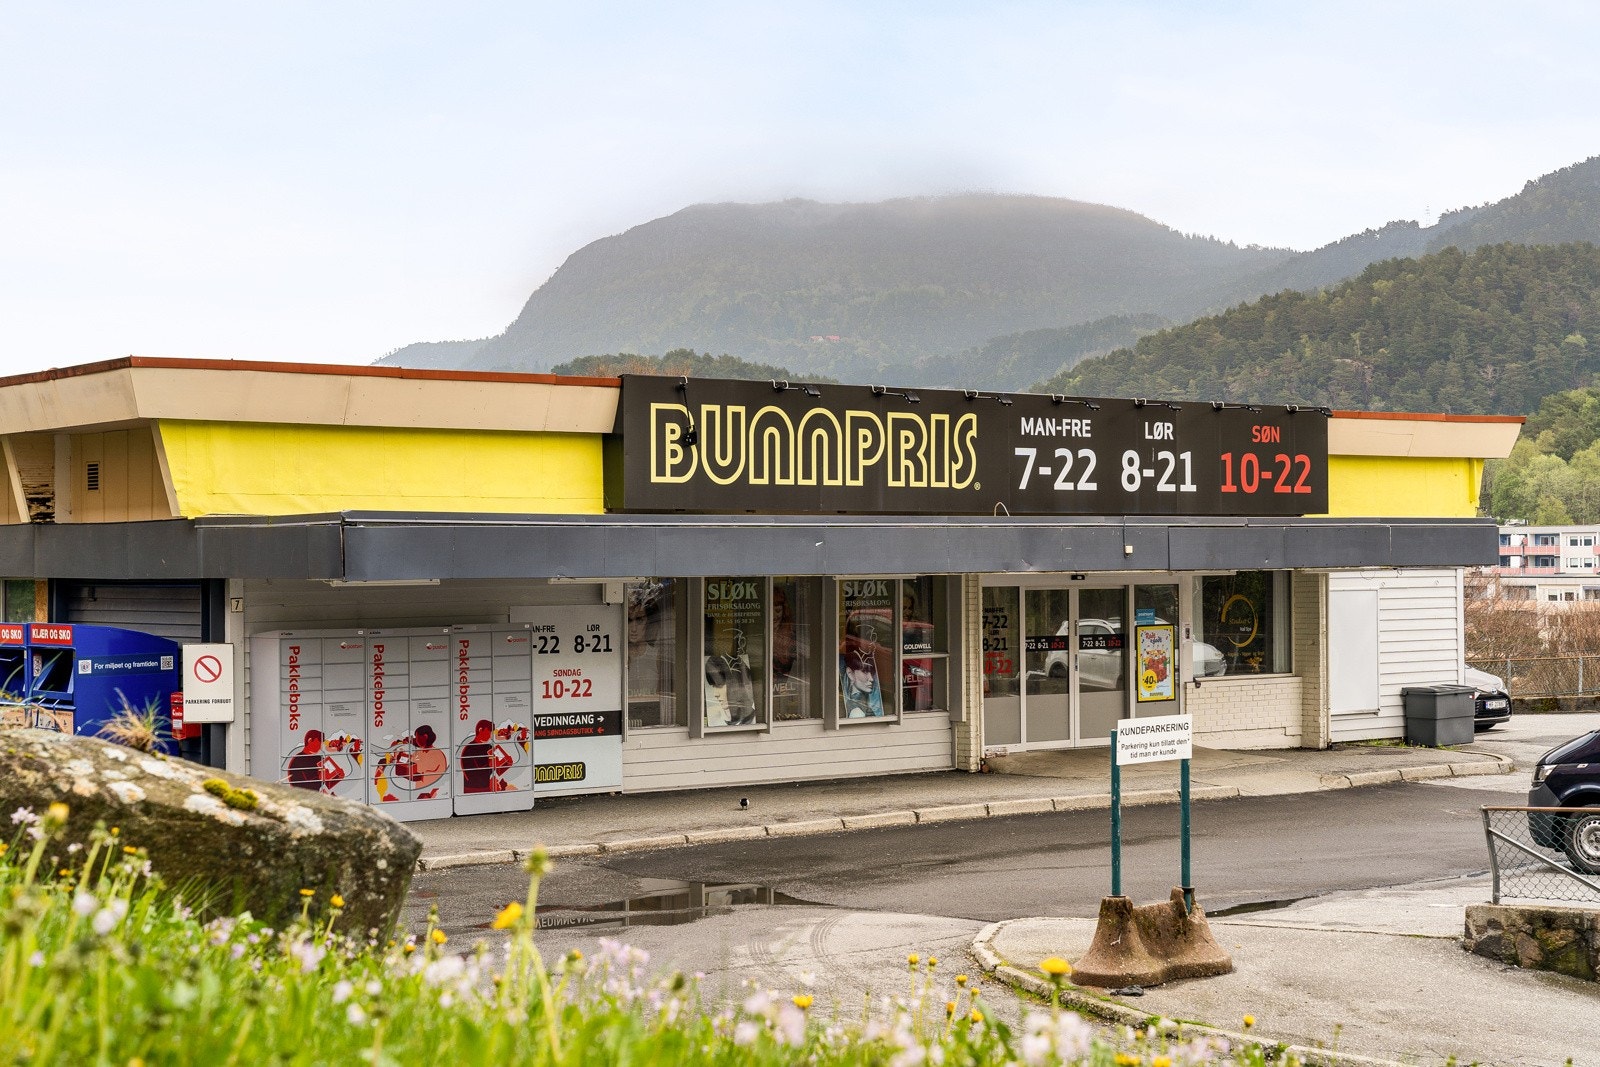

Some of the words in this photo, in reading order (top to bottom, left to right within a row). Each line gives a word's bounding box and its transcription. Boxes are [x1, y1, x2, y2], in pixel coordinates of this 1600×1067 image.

[1020, 417, 1092, 437] MAN-FRE
[1144, 421, 1174, 441] LØR
[1252, 425, 1280, 443] SØN
[650, 403, 977, 489] BUNNPRIS
[1014, 447, 1097, 491] 7-22
[1121, 449, 1197, 492] 8-21
[1221, 452, 1312, 494] 10-22
[707, 581, 759, 602] SLØK
[843, 580, 889, 598] SLØK
[235, 600, 240, 610] 7
[707, 602, 761, 610] FRISØRSALONG
[586, 624, 600, 632] LØR
[982, 615, 1008, 629] 7-22
[1, 629, 10, 639] OG
[10, 629, 22, 640] SKO
[32, 628, 49, 639] KLÆR
[49, 629, 58, 639] OG
[58, 629, 71, 641] SKO
[573, 634, 613, 654] 8-21
[982, 637, 1009, 651] 8-21
[1037, 642, 1049, 650] 8-21
[1082, 640, 1094, 648] 7-22
[124, 662, 132, 670] og
[132, 660, 159, 668] framtiden
[553, 668, 582, 677] SØNDAG
[373, 644, 385, 729] Pakkeboks
[458, 639, 470, 721] Pakkeboks
[288, 645, 300, 731] Pakkeboks
[542, 679, 593, 699] 10-22
[1120, 722, 1190, 736] KUNDEPARKERING
[1121, 742, 1148, 751] Parkering
[1161, 739, 1176, 747] tillatt
[1159, 748, 1177, 756] kunde
